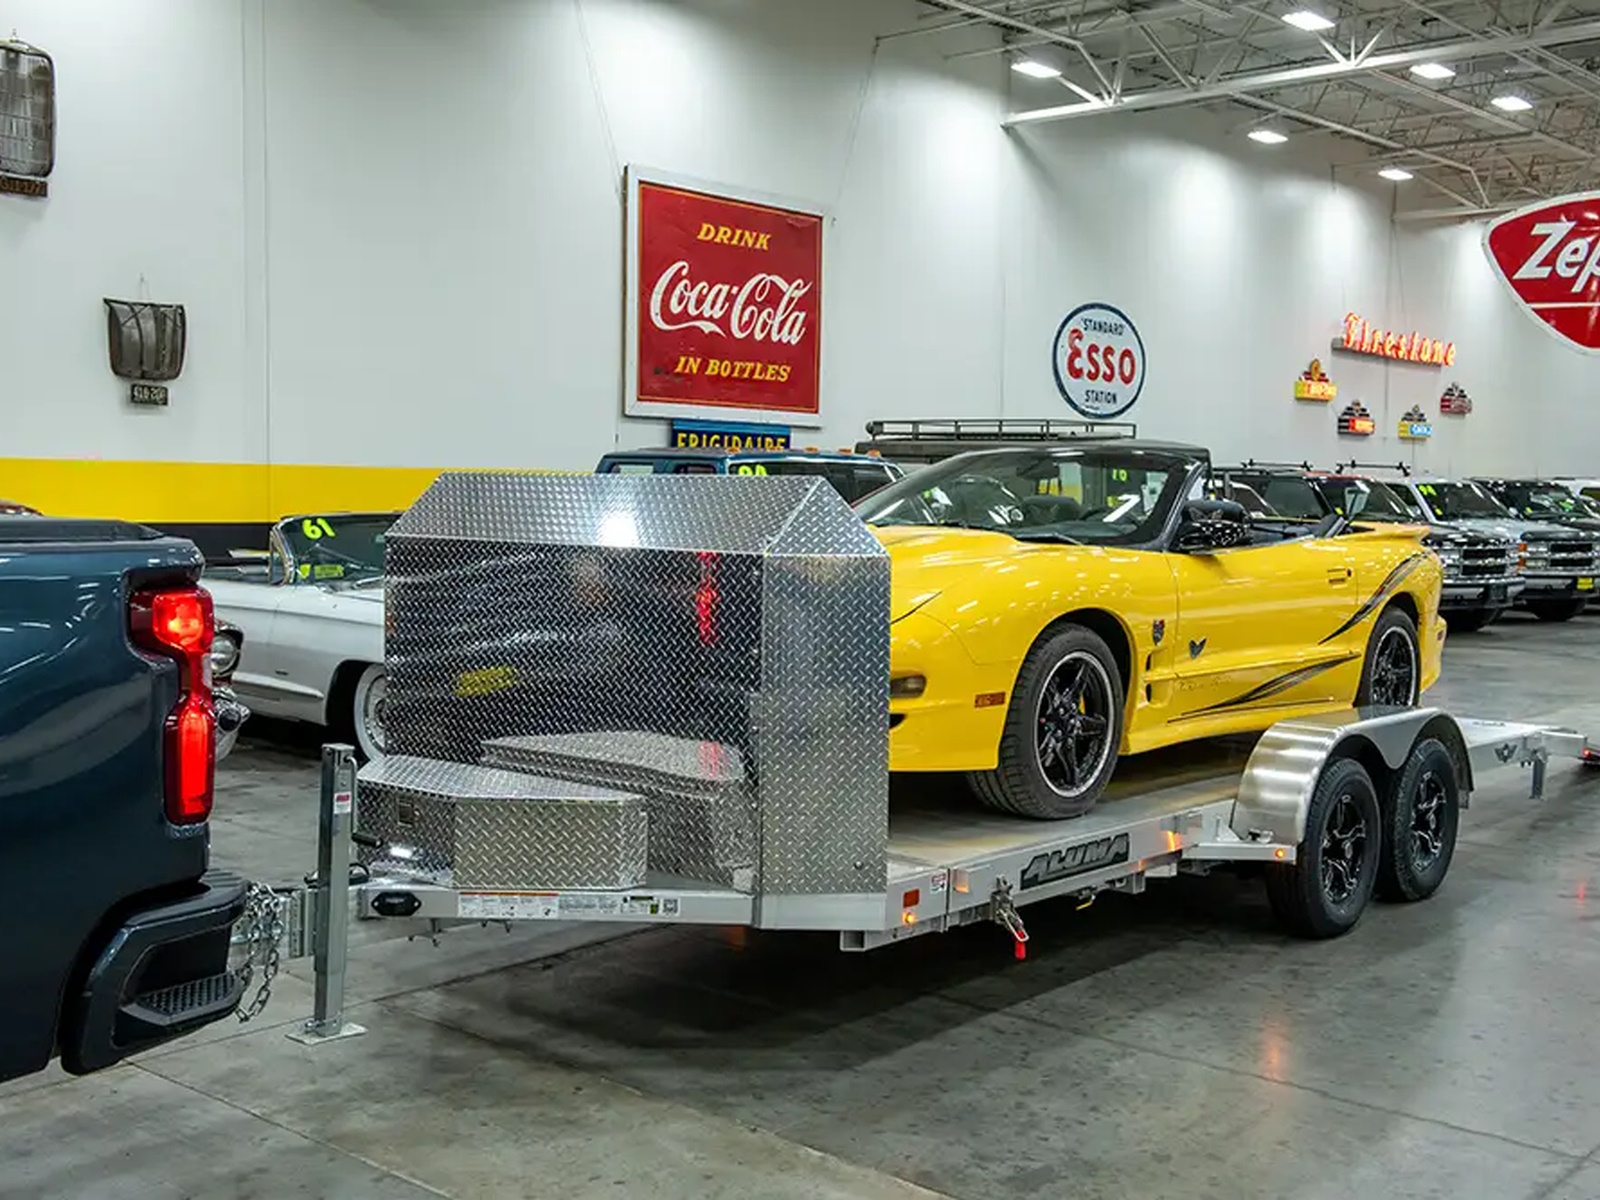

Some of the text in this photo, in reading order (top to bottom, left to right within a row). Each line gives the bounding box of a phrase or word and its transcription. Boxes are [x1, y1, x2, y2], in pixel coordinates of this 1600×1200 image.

[697, 222, 772, 250] DRINK
[1082, 318, 1124, 336] STANDARD
[1343, 312, 1456, 367] Firestone
[674, 355, 792, 382] IN BOTTLES
[1084, 389, 1118, 404] STATION
[302, 518, 336, 540] 61
[1022, 833, 1129, 884] ALUMA
